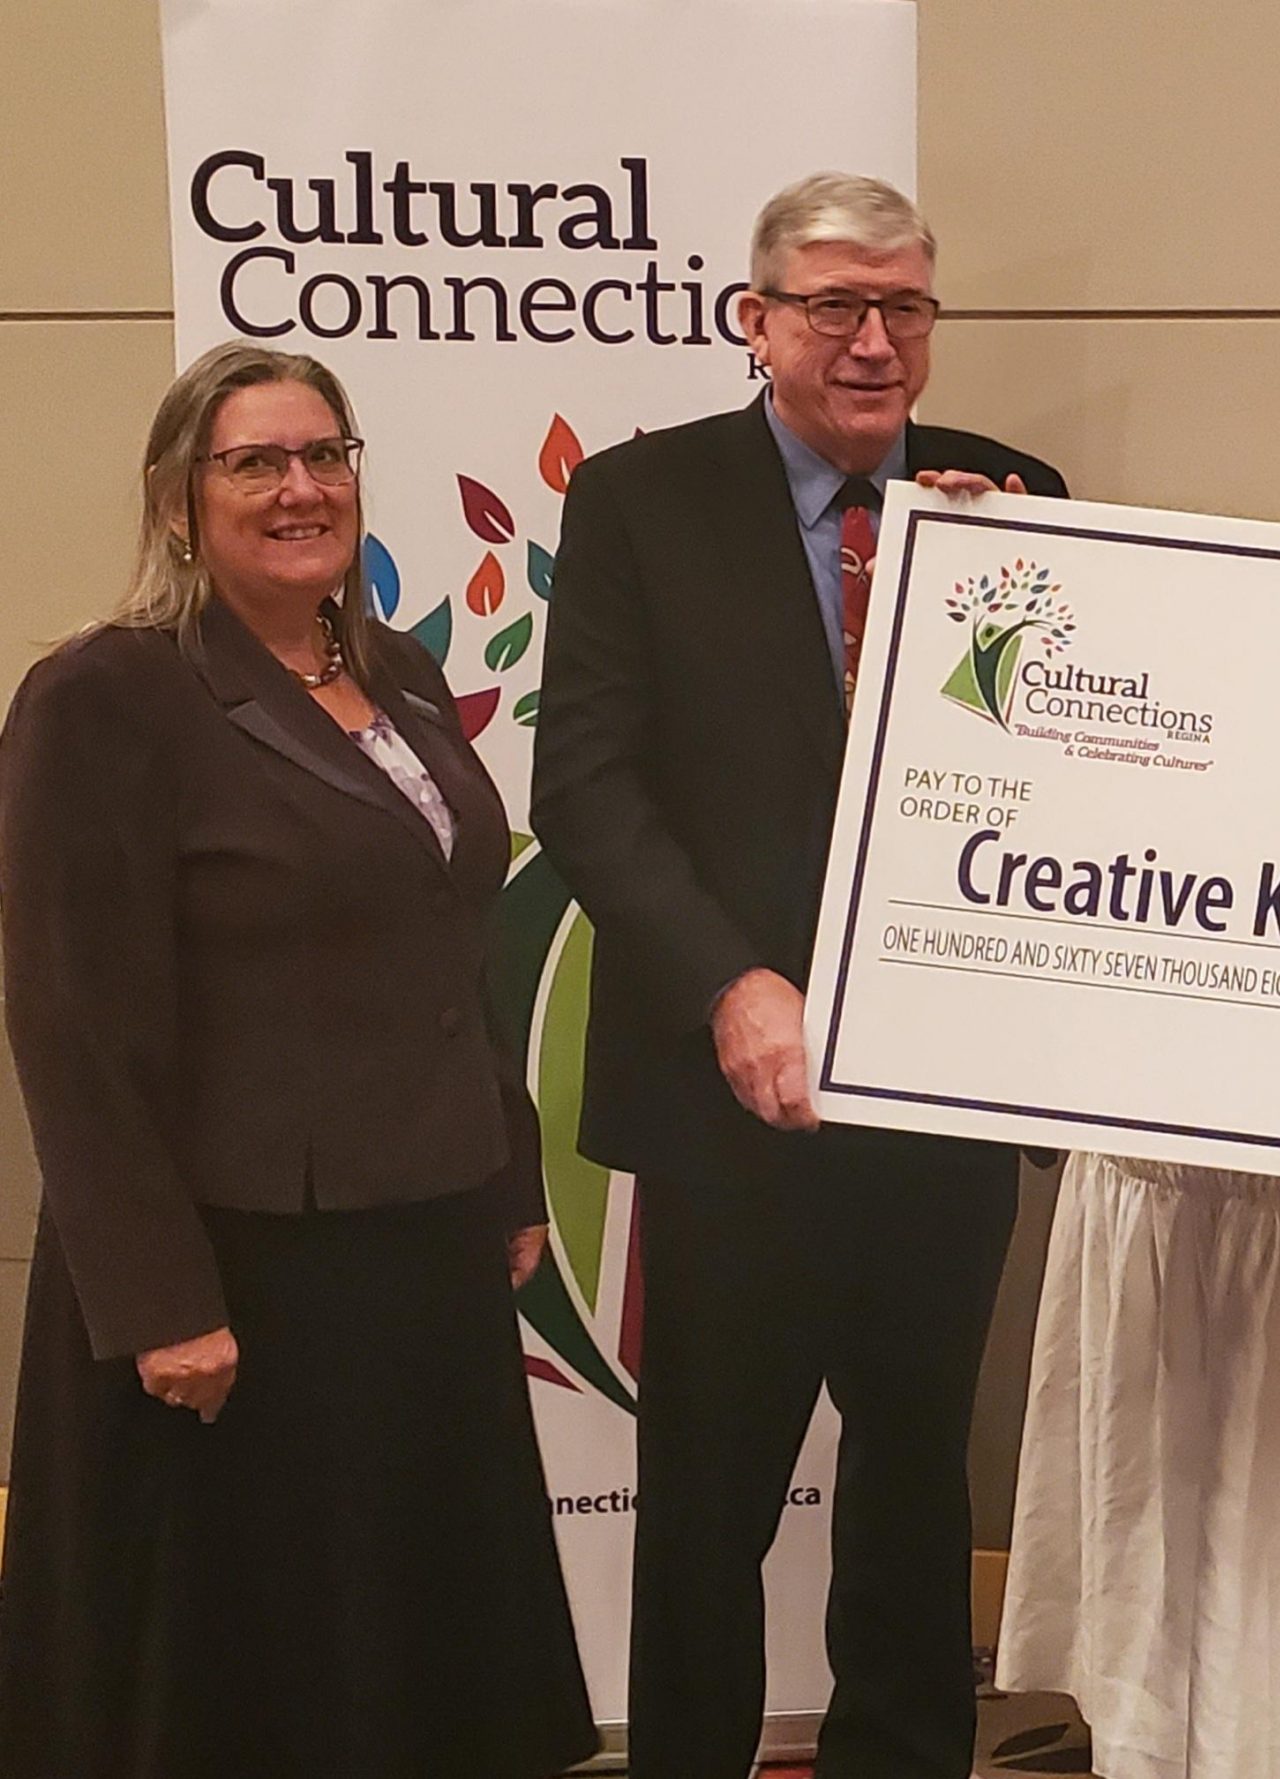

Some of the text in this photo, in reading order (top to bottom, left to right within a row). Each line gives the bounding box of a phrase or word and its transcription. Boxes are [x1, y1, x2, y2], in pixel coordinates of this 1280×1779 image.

[190, 150, 658, 251] Cultural
[1021, 661, 1149, 699] Cultural
[1025, 688, 1213, 733] Connections
[1074, 731, 1160, 751] Communities
[1166, 730, 1211, 744] REGINA
[1064, 745, 1074, 757] &
[1077, 745, 1151, 767] Celebrating
[904, 768, 1033, 801] PAY TO THE
[900, 796, 1019, 828] ORDER OF
[957, 829, 1234, 932] Creative
[882, 925, 921, 953] ONE
[922, 933, 1008, 963] HUNDRED
[1010, 940, 1049, 968] AND
[1052, 944, 1104, 976] SIXTY
[1104, 950, 1158, 982] SEVEN
[1161, 957, 1258, 993] THOUSAND
[550, 1487, 638, 1515] necti
